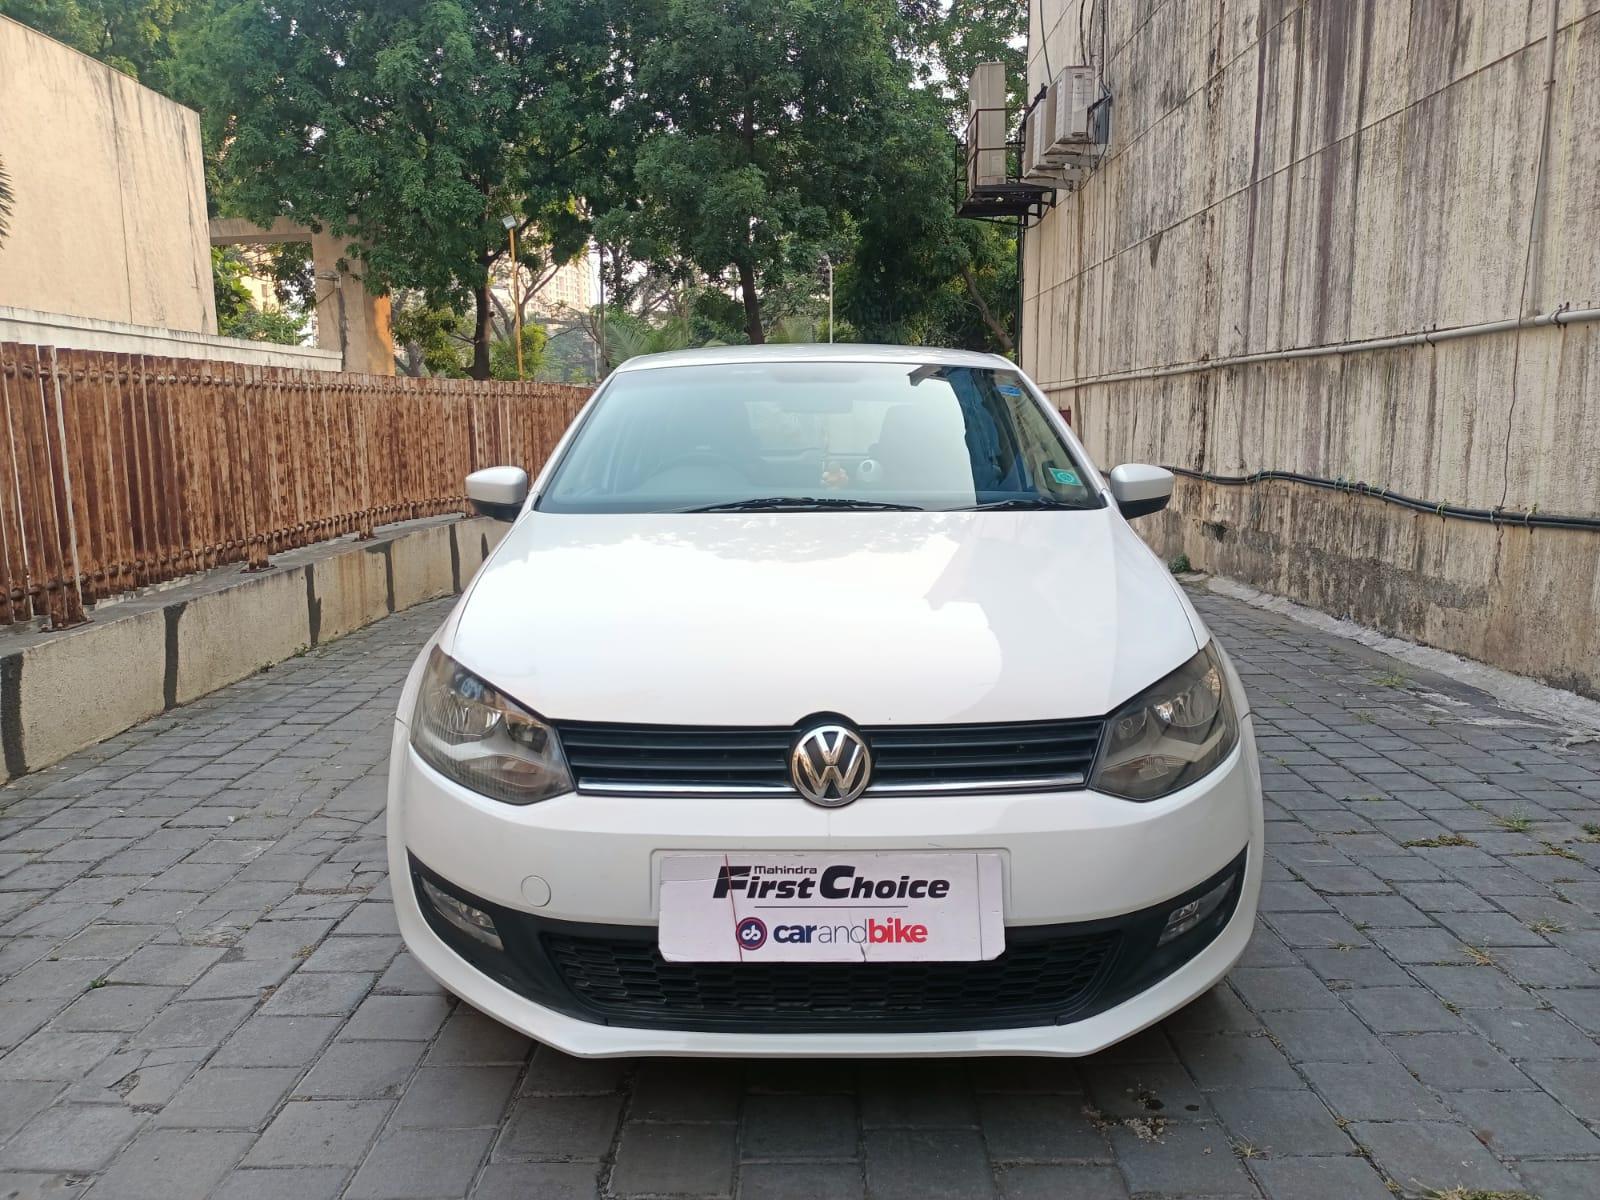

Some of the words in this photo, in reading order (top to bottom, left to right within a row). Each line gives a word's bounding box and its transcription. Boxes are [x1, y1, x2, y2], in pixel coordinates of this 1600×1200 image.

[792, 726, 871, 807] VW
[713, 865, 816, 899] First
[819, 865, 951, 899] Choice
[754, 865, 818, 875] Mahindra
[773, 918, 928, 944] carandbike
